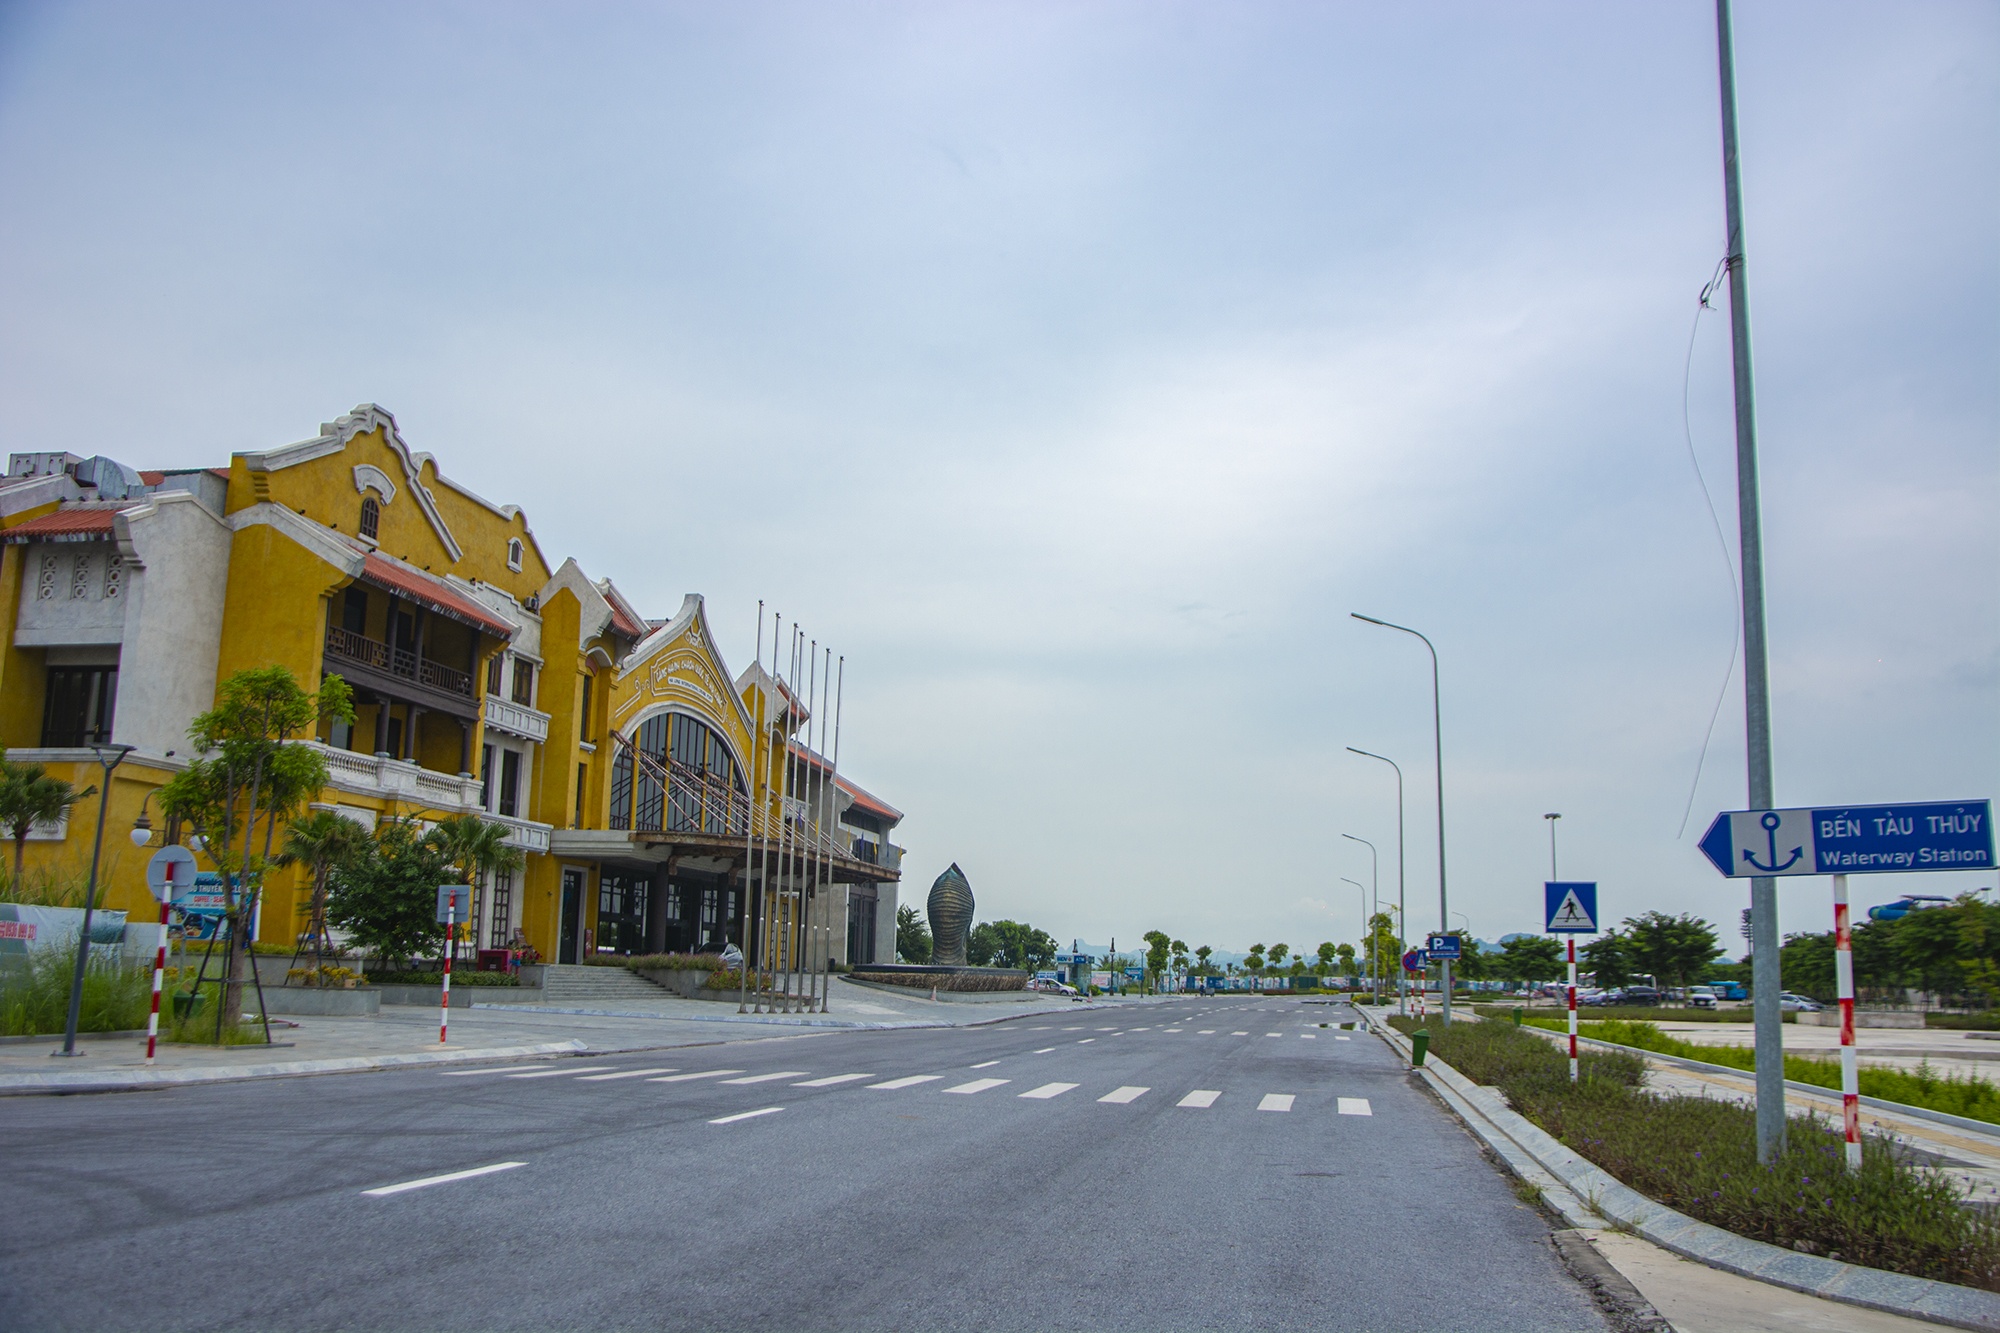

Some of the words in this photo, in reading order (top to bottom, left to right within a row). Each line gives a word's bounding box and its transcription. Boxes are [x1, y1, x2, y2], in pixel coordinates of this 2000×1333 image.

[1821, 811, 1861, 838] BẾN
[1873, 811, 1914, 836] TÀU
[1926, 807, 1982, 834] THỦY
[1823, 850, 1915, 867] Waterway
[1919, 847, 1987, 863] Station
